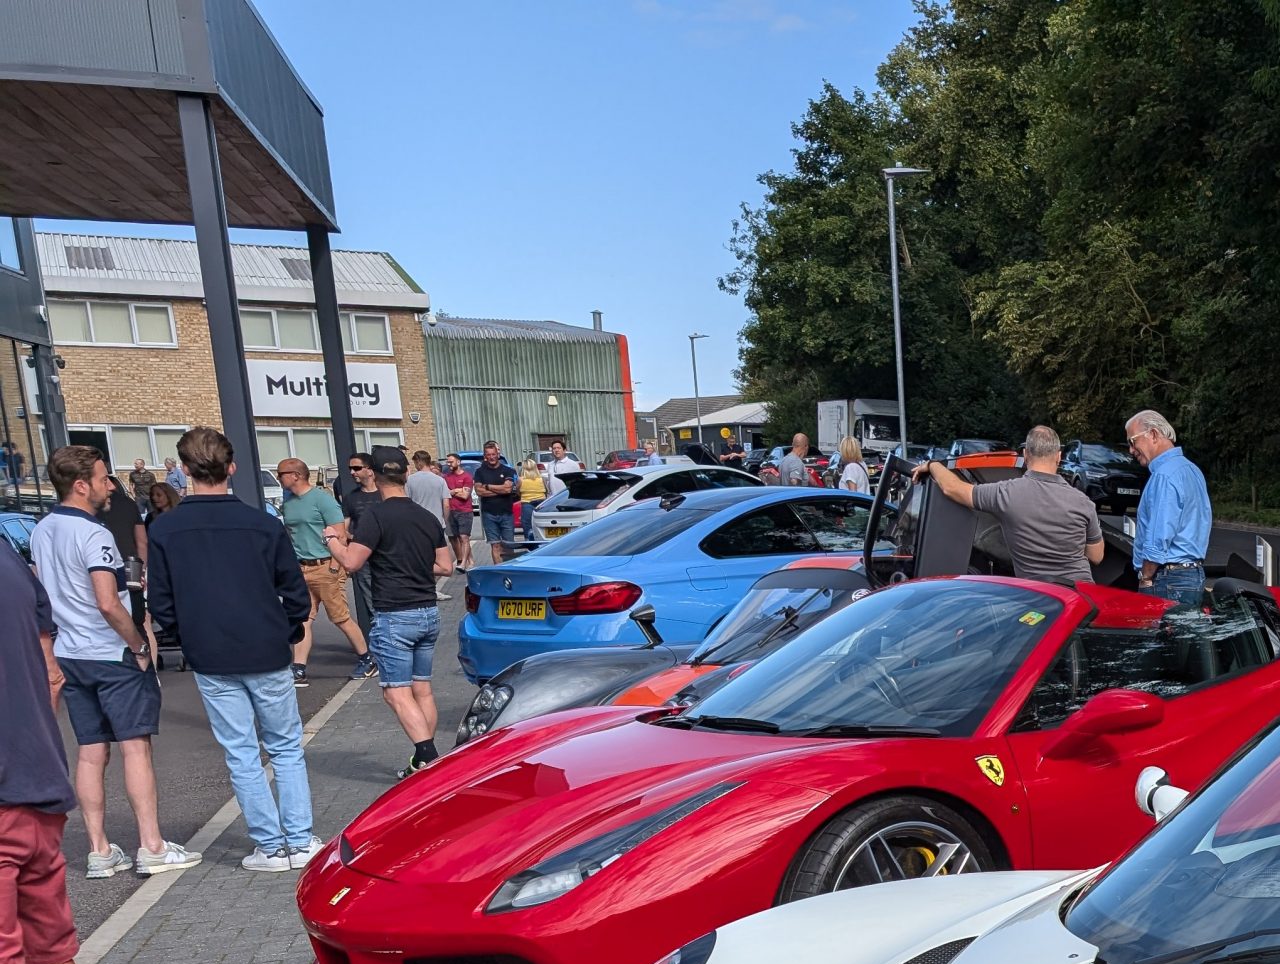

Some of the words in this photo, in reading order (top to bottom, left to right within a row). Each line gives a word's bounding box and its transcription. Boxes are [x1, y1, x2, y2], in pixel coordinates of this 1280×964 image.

[265, 374, 381, 406] Multiay
[101, 545, 114, 564] 3
[500, 601, 523, 617] YG70
